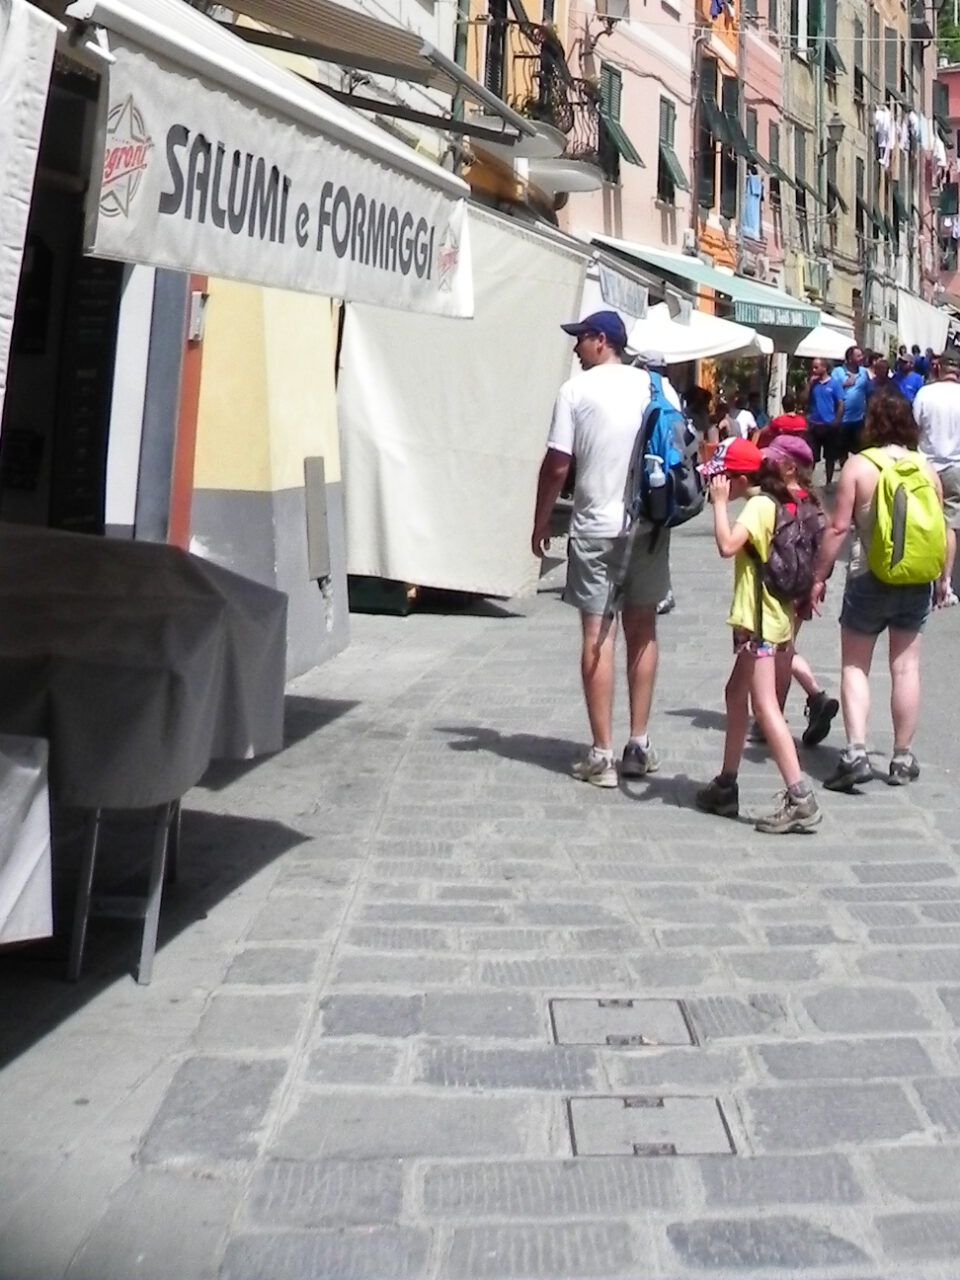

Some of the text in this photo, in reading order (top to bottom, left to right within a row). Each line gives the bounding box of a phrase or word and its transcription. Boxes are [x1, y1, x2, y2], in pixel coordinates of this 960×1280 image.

[158, 123, 435, 280] SALUMI e FORMAGGI
